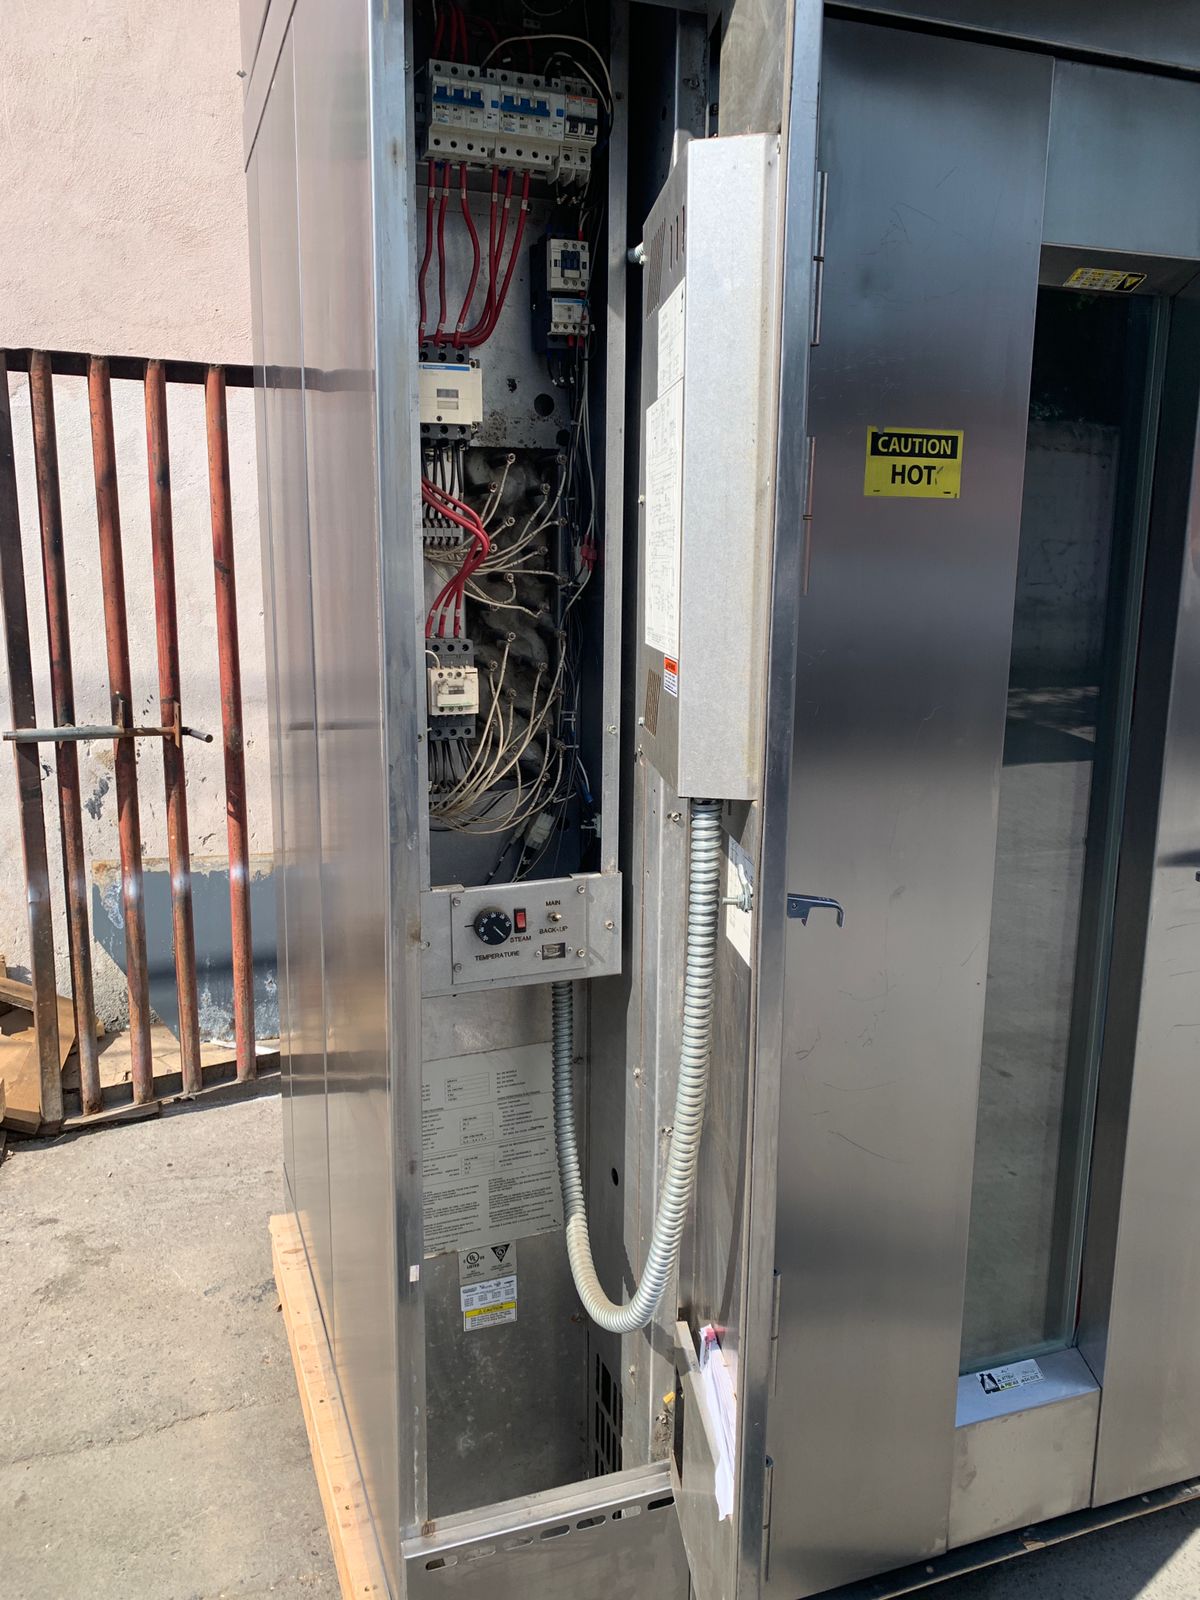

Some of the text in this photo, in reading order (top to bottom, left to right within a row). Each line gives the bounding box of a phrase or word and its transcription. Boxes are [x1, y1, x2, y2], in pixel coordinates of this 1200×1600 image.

[877, 436, 952, 455] CAUTION
[891, 463, 936, 485] HOT
[539, 925, 568, 934] BACK-UP
[475, 950, 520, 961] TEMPERATURE
